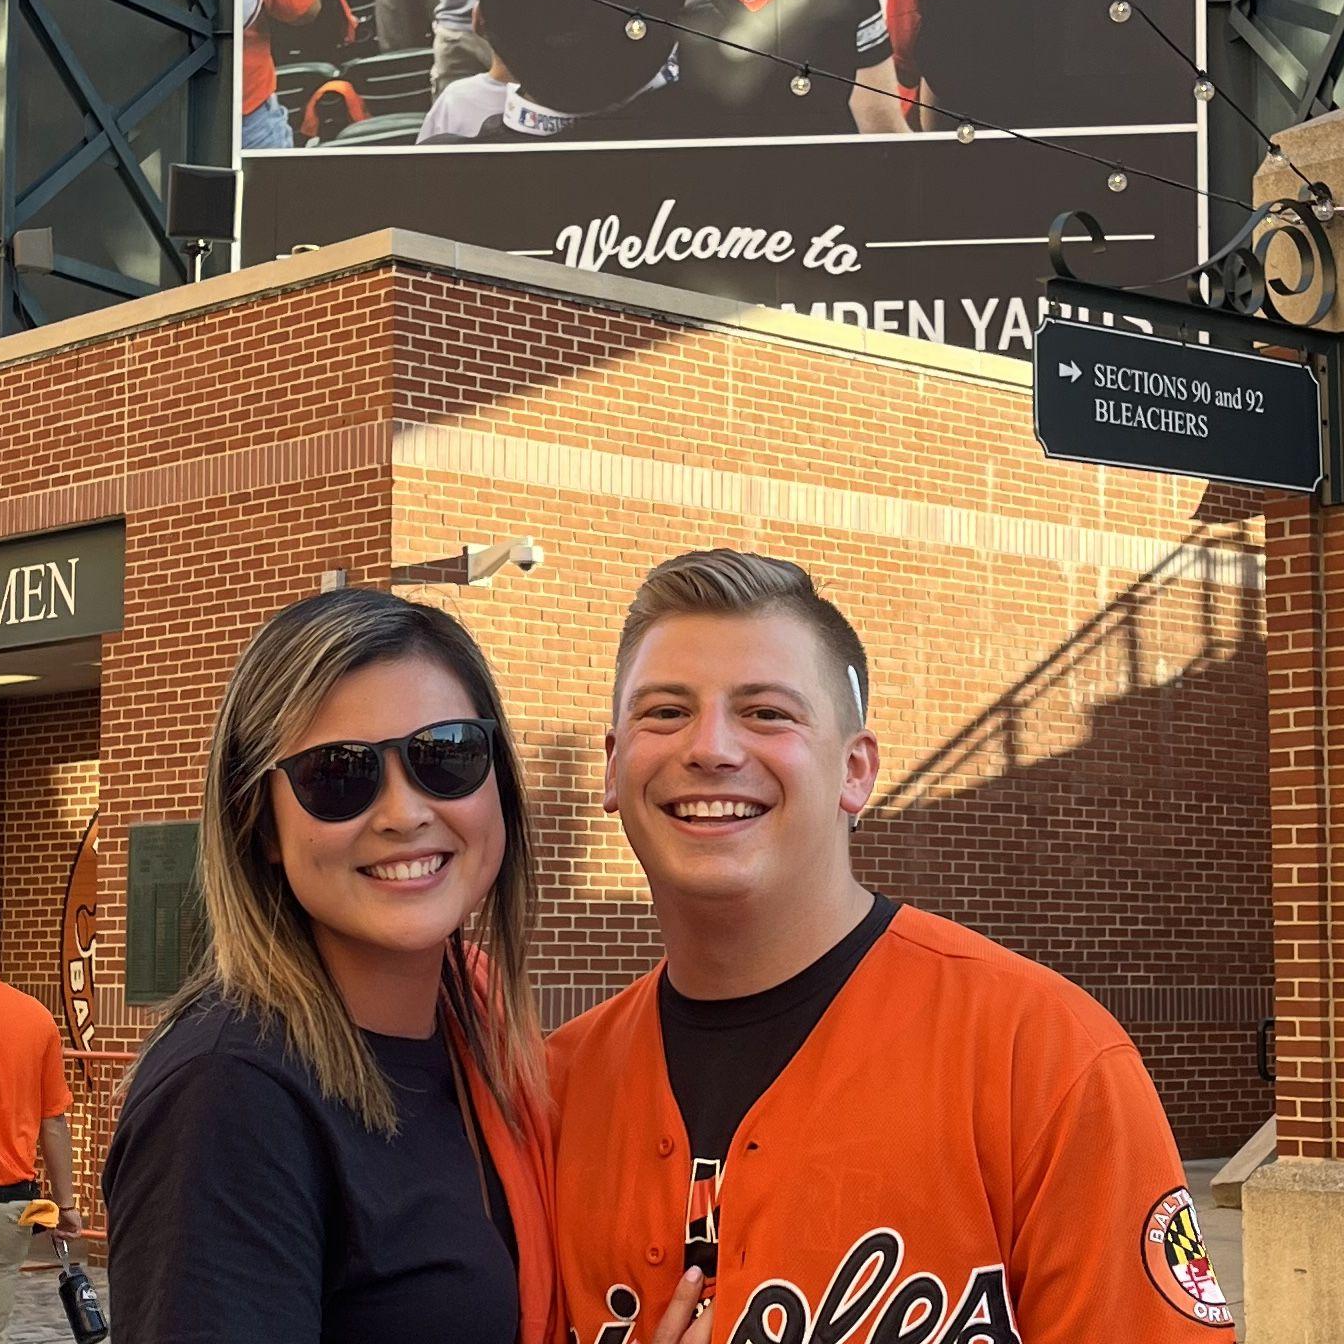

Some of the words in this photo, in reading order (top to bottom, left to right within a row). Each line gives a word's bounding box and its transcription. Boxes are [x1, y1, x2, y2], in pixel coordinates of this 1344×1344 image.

[555, 198, 796, 273] Welcome
[802, 224, 862, 275] to
[1093, 363, 1187, 401] SECTIONS
[1191, 380, 1212, 405] 90
[1215, 387, 1243, 410] and
[1245, 389, 1265, 414] 92
[1094, 398, 1209, 438] BLEACHERS
